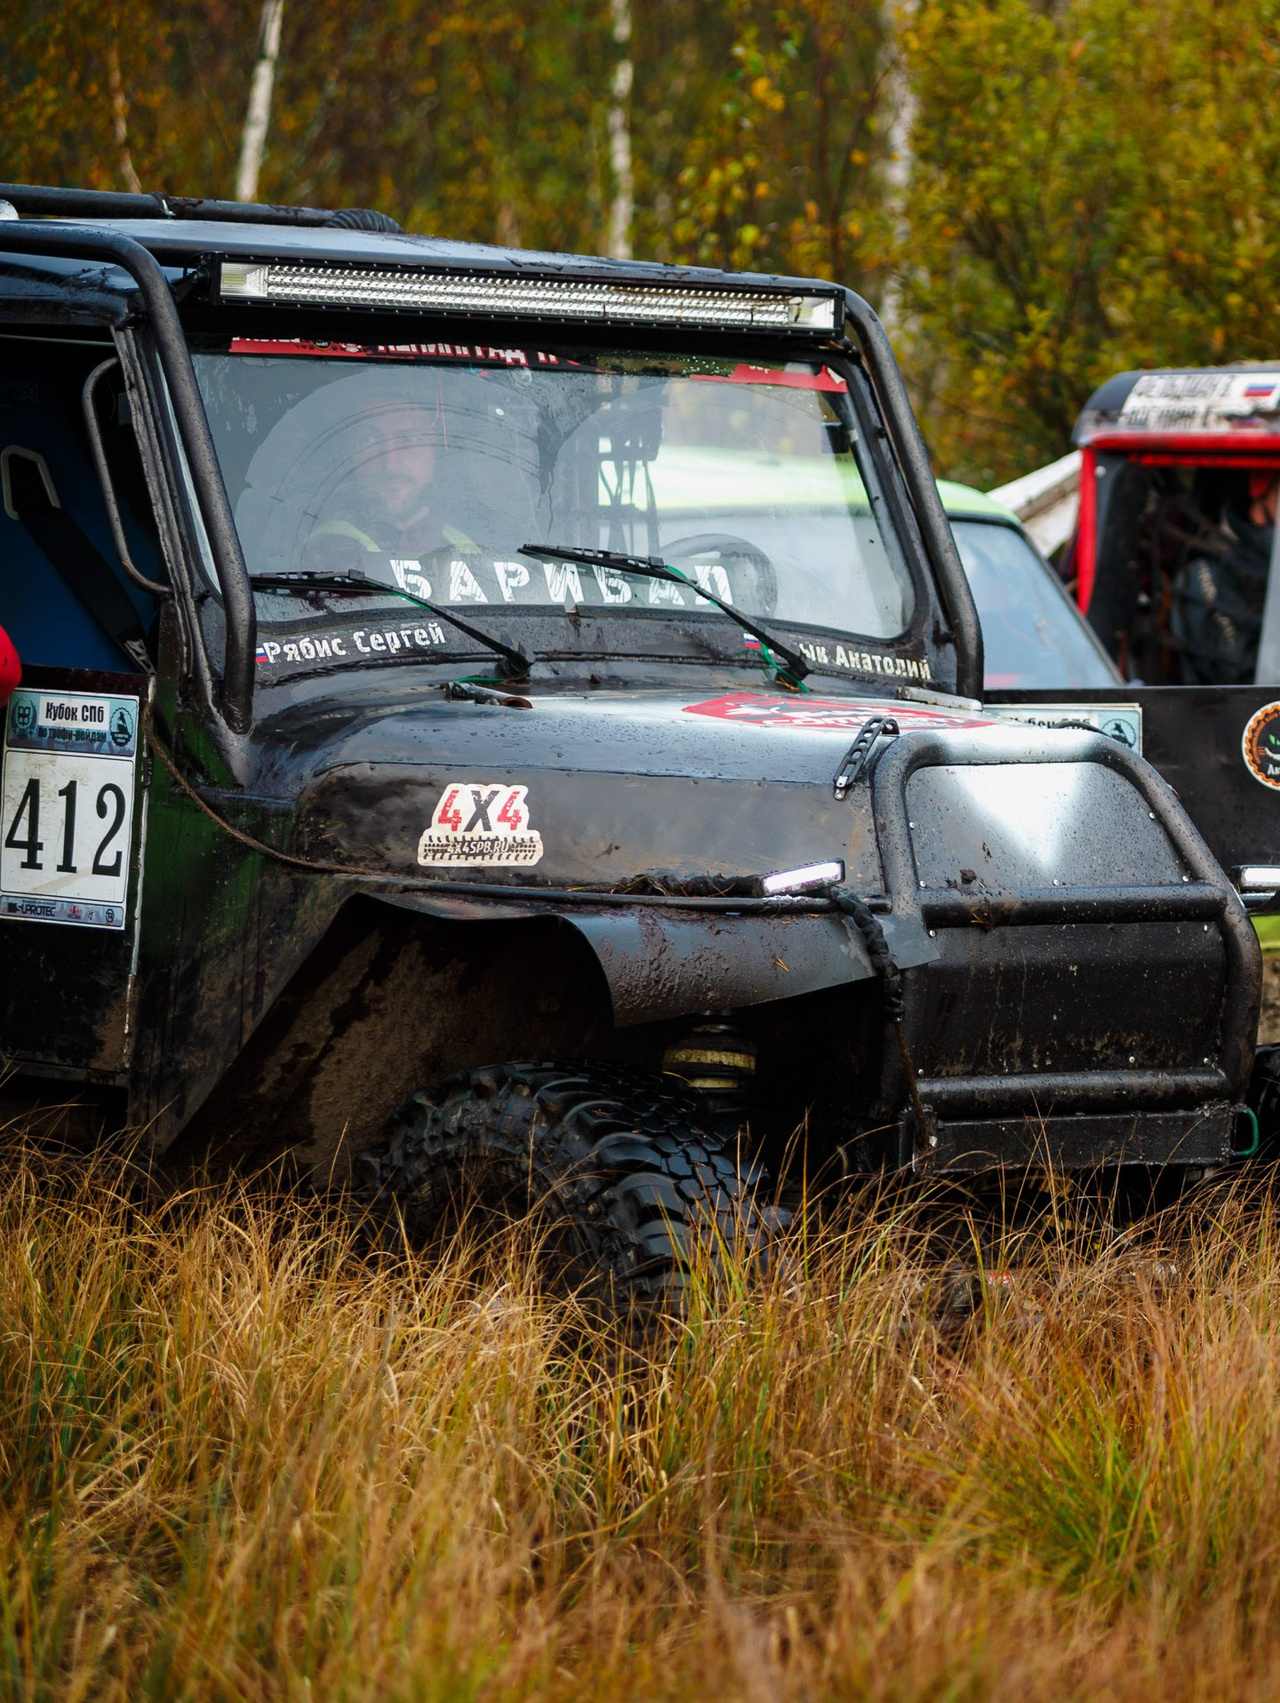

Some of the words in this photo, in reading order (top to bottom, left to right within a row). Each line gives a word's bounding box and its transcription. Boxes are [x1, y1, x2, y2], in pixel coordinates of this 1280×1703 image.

[390, 560, 734, 606] БАРИБАЛ
[263, 637, 347, 664] Рябис
[353, 622, 447, 654] Сергей
[835, 645, 932, 680] Анатолий
[45, 702, 78, 721] Кубок
[81, 704, 105, 723] СПб
[5, 778, 126, 877] 412
[437, 789, 522, 832] 4X4
[447, 841, 509, 854] 4X4SPB.RU
